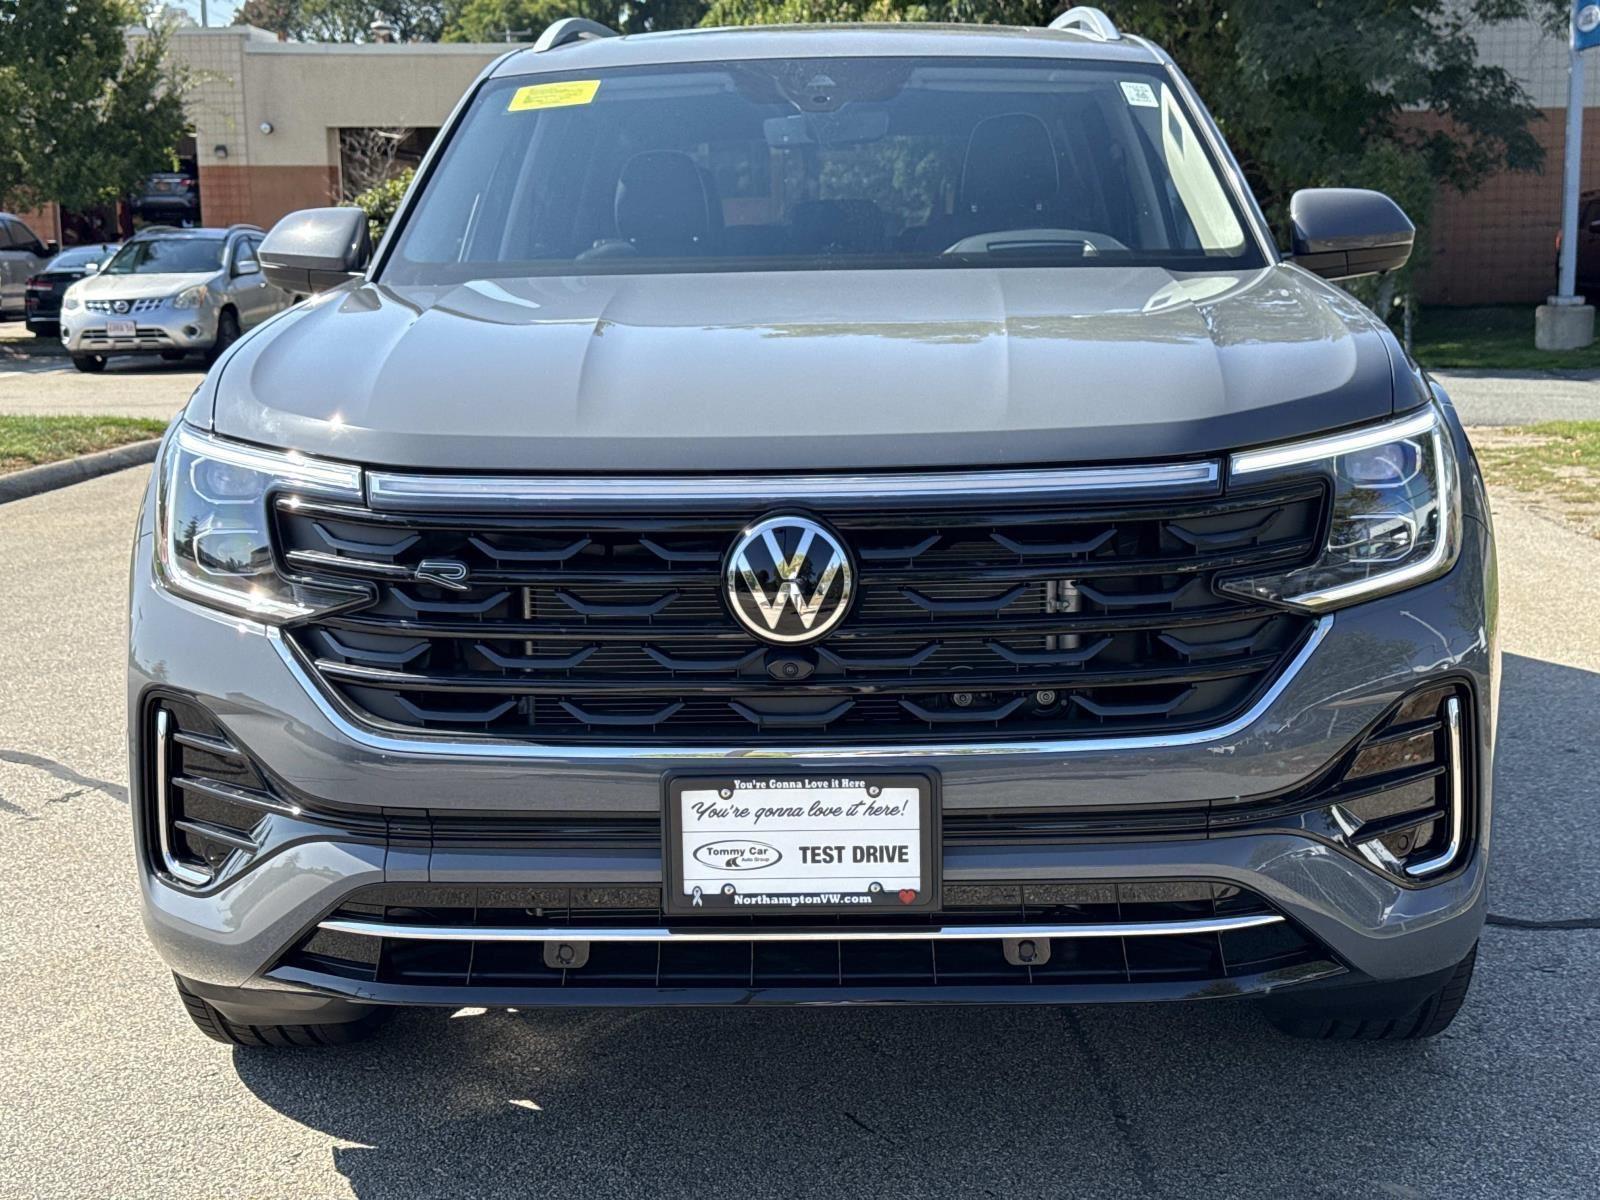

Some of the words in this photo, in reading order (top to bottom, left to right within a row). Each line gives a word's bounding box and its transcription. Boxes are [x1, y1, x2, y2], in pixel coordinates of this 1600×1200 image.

[415, 559, 470, 591] R
[735, 525, 844, 630] VW
[734, 780, 766, 789] You're
[769, 779, 802, 789] Gonna
[805, 779, 828, 788] Love
[831, 779, 839, 788] it
[841, 779, 865, 788] Here
[691, 802, 750, 821] You're
[754, 807, 804, 825] gonna
[808, 800, 843, 817] love
[846, 800, 866, 816] it
[863, 800, 909, 816] here!
[707, 847, 745, 856] Tommy
[749, 847, 768, 855] Car
[799, 846, 845, 864] TEST
[852, 845, 909, 863] DRIVE
[734, 894, 872, 906] NorthamptonVW.com
